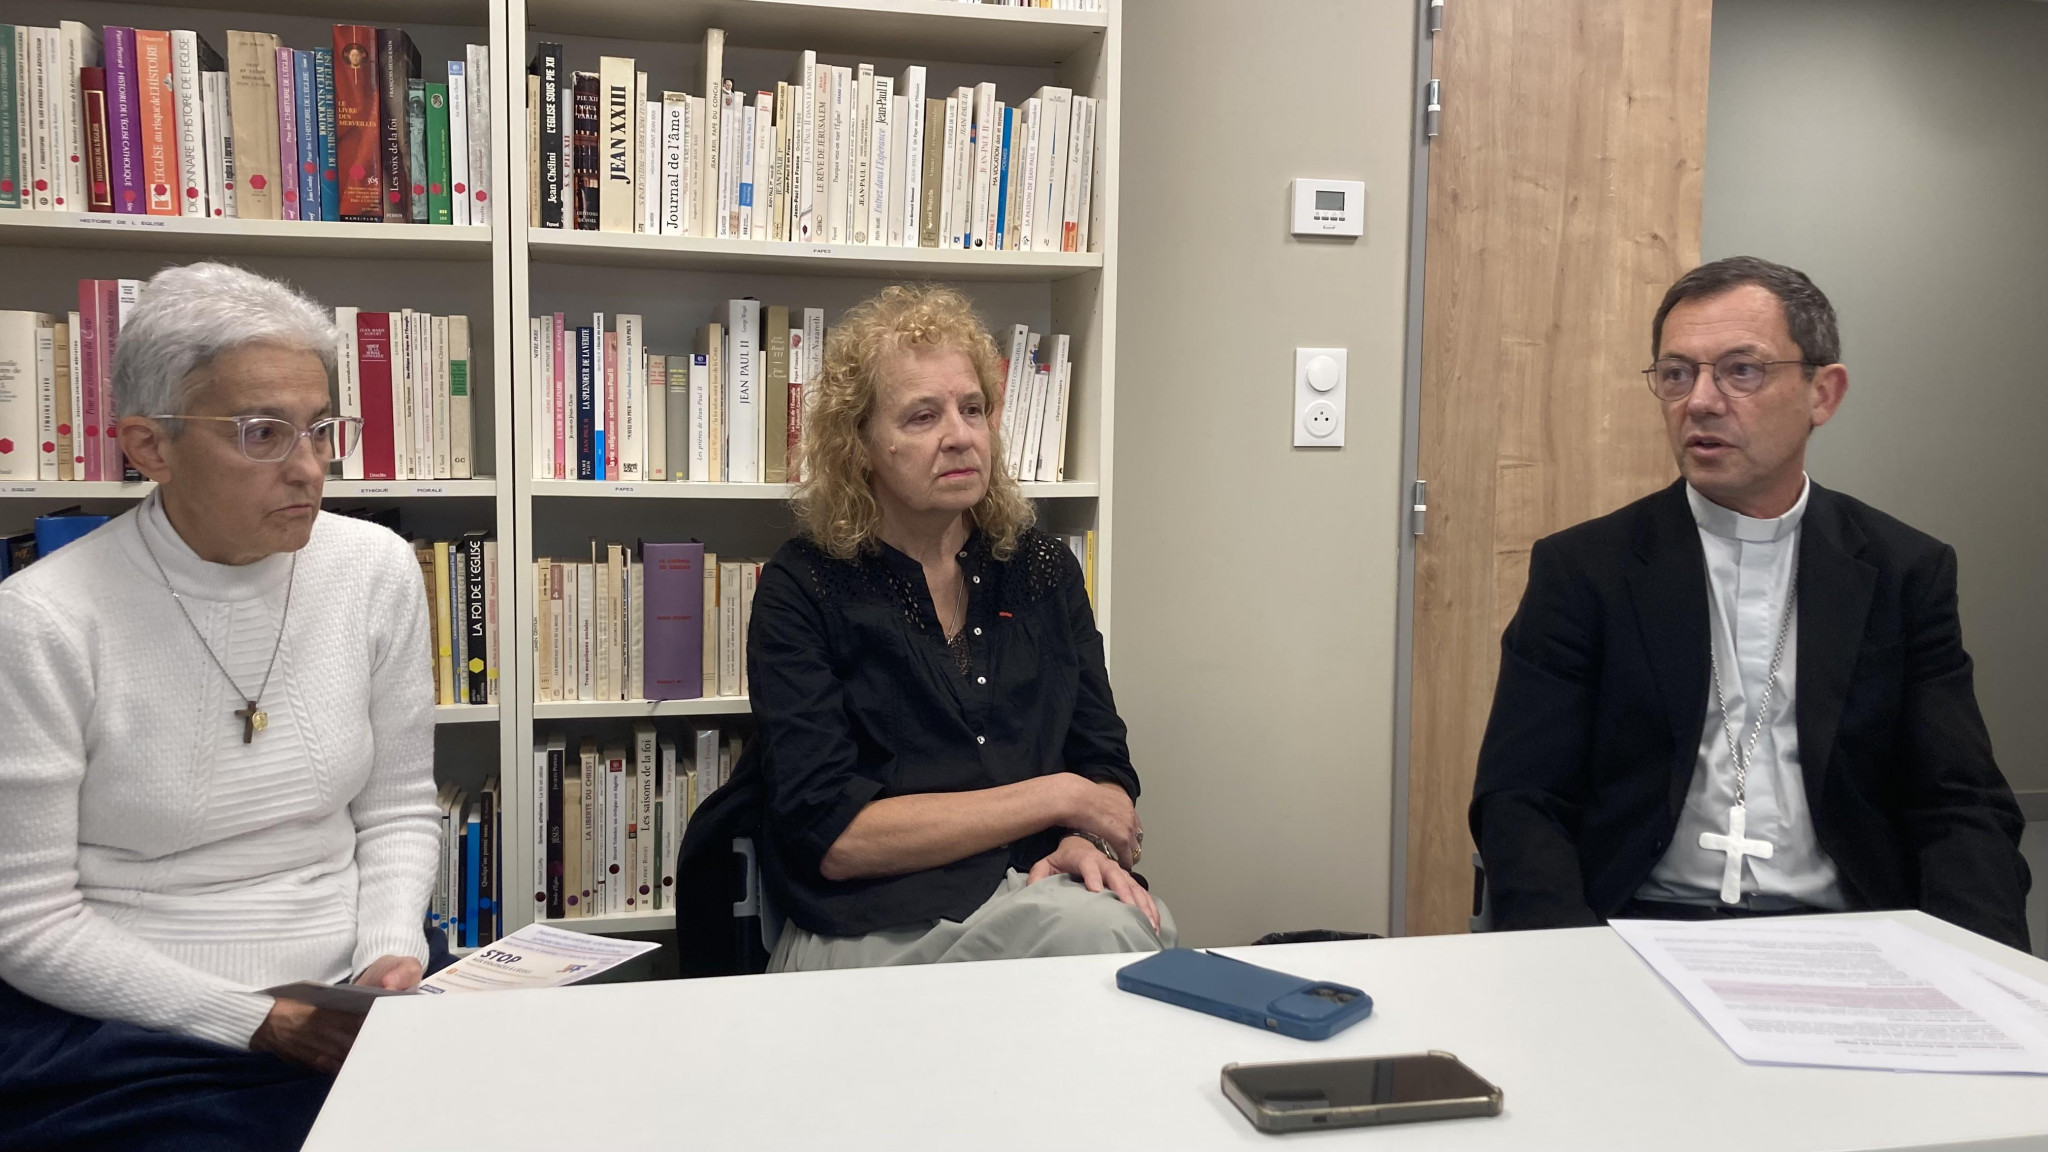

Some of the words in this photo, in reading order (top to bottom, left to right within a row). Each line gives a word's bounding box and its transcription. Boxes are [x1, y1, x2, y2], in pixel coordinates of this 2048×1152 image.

[545, 57, 555, 67] XII
[181, 75, 192, 90] DE
[546, 69, 555, 80] PIE
[117, 72, 127, 102] HISTOIRE
[546, 83, 555, 102] SOUS
[318, 89, 326, 121] POINTS
[326, 95, 334, 104] DE
[875, 88, 888, 125] Jean-Paul
[120, 104, 127, 113] DE
[610, 85, 626, 134] XXIII
[712, 110, 718, 119] DU
[387, 118, 397, 130] foi
[546, 104, 556, 133] L'EGLISE
[817, 102, 826, 146] JÉRUSALEM
[667, 110, 680, 150] l'âme
[388, 143, 398, 153] de
[817, 148, 825, 159] DE
[122, 141, 132, 186] CATHOLIQUE
[328, 154, 336, 166] DE
[390, 156, 399, 174] voix
[547, 153, 557, 182] Chélini
[610, 138, 631, 184] JEAN
[667, 153, 680, 169] de
[184, 146, 199, 213] DICONNAIRE
[816, 161, 825, 182] RÊVE
[390, 177, 400, 191] Les
[875, 171, 884, 189] dans
[992, 177, 998, 186] MA
[1027, 182, 1032, 190] DE
[548, 184, 557, 203] Jean
[816, 184, 824, 193] LE
[666, 172, 679, 229] Journal
[874, 190, 883, 214] Entrez
[812, 316, 820, 350] Nazareth
[740, 340, 748, 348] II
[740, 352, 749, 376] PAUL
[606, 373, 615, 400] Jean-Paul
[740, 380, 751, 404] JEAN
[582, 401, 590, 410] LA
[607, 402, 615, 418] selon
[607, 421, 616, 450] religieuse
[469, 541, 481, 581] L'EGLISE
[470, 585, 481, 598] DE
[471, 602, 482, 619] FOI
[471, 622, 483, 636] LA
[641, 740, 652, 753] foi
[641, 755, 651, 764] la
[641, 766, 651, 777] de
[585, 790, 592, 800] DU
[642, 780, 651, 813] saisons
[641, 816, 650, 831] Les
[585, 831, 592, 840] LA
[480, 949, 523, 964] STOP
